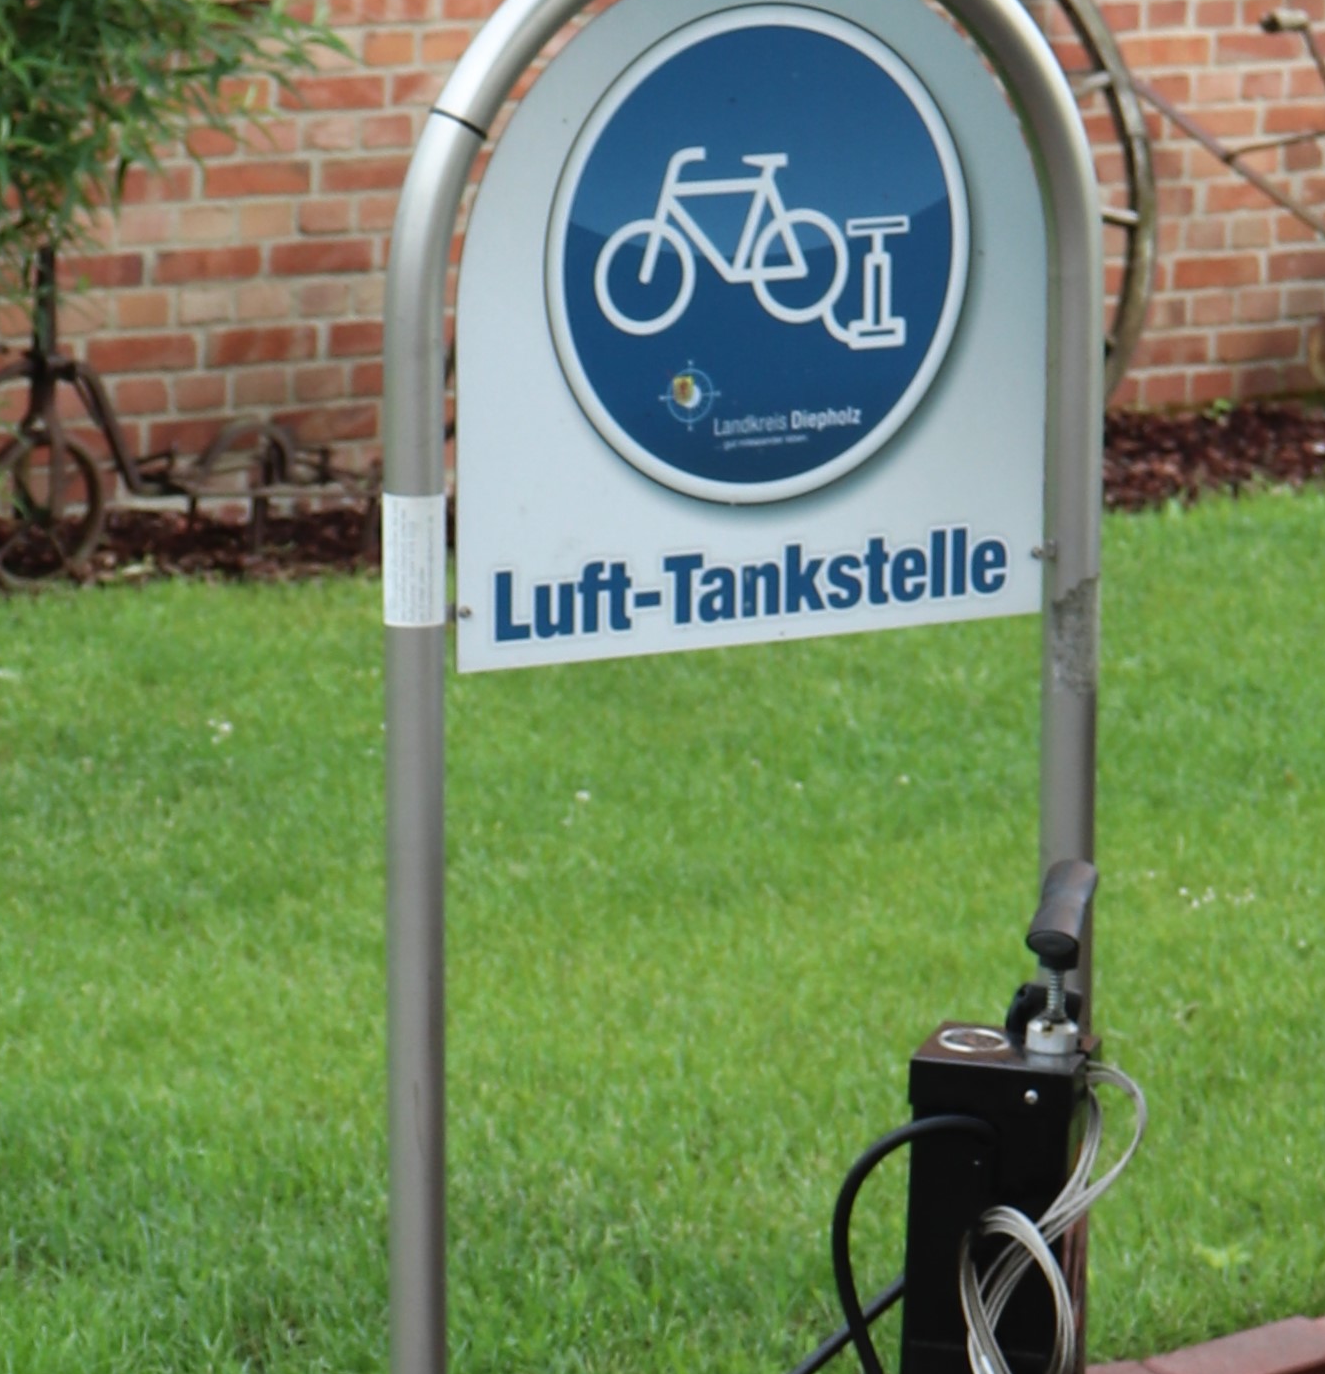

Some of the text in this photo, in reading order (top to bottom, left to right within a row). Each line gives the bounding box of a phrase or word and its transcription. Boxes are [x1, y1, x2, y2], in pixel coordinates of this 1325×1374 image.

[713, 405, 862, 437] Landkreis Diepholz
[494, 527, 1007, 642] Luft-Tankstelle
